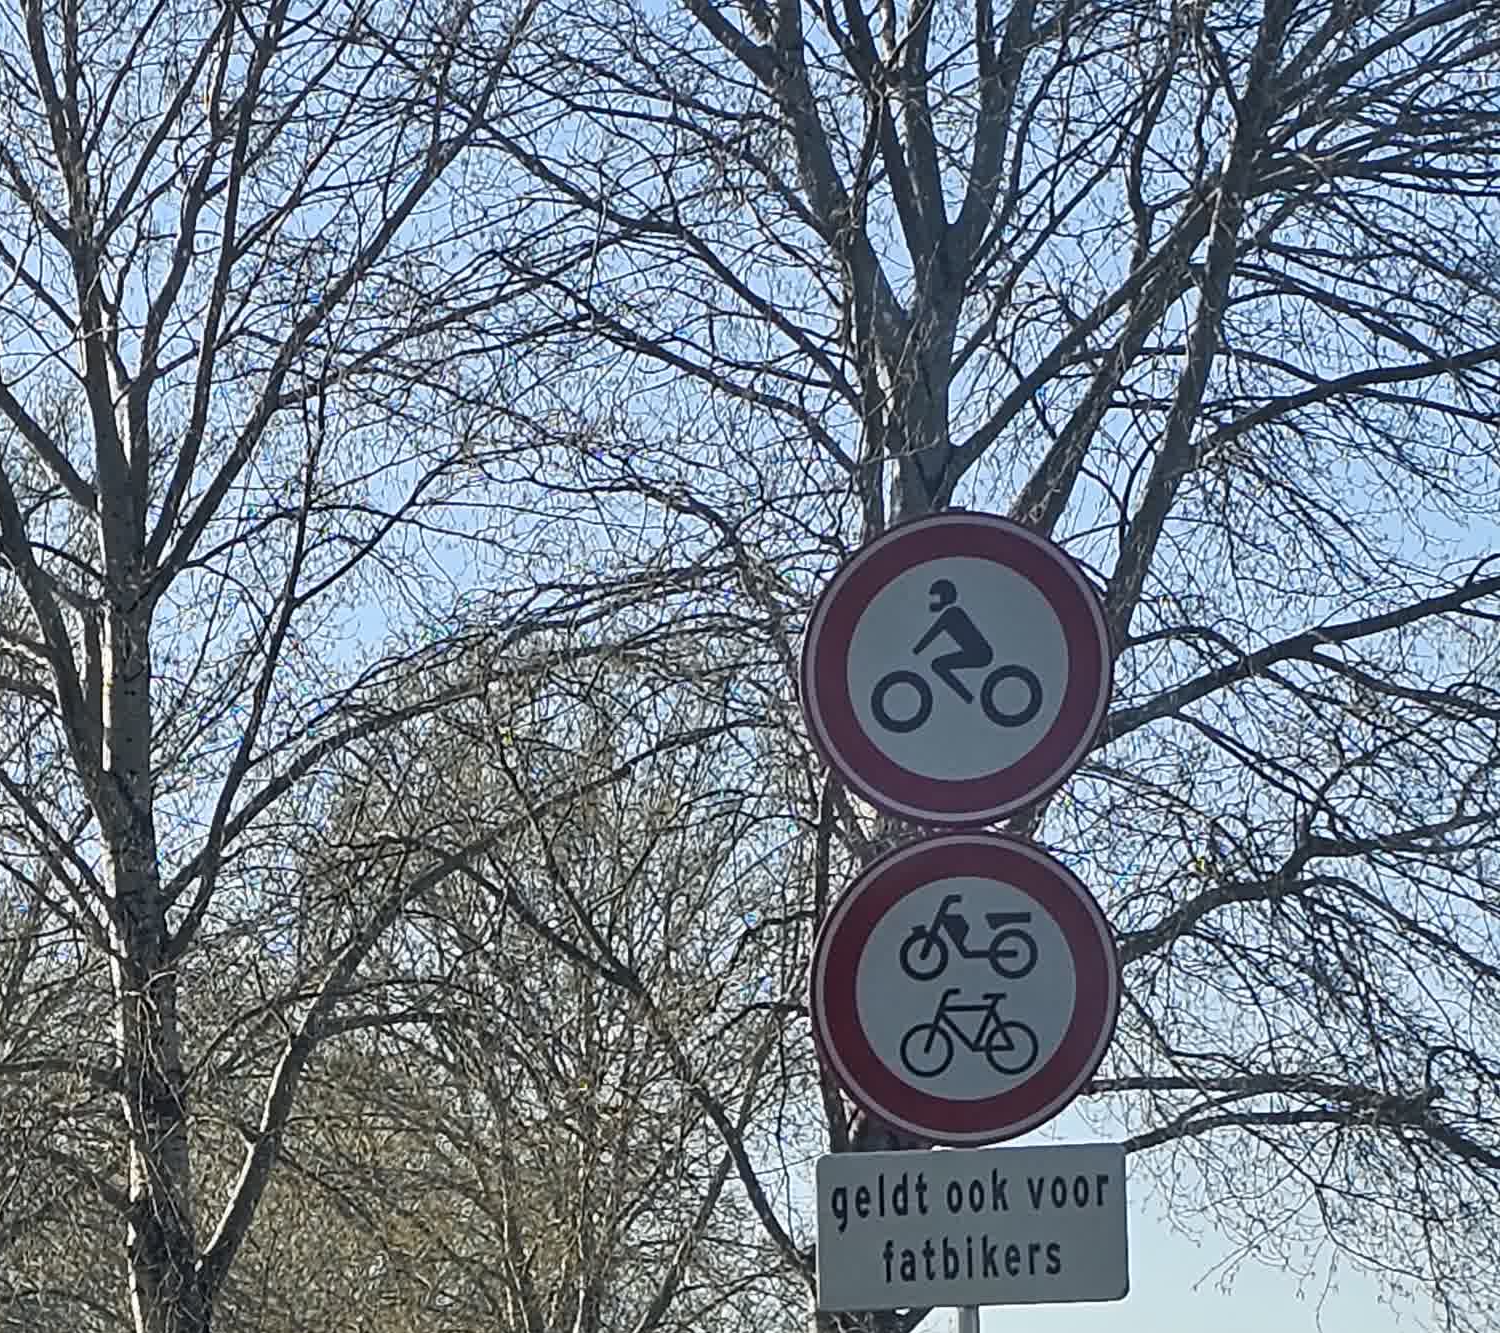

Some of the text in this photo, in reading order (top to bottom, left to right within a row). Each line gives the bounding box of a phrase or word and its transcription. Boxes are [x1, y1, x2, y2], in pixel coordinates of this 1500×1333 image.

[831, 1168, 1109, 1232] geldt ook voor
[882, 1235, 1062, 1283] fatbikers
